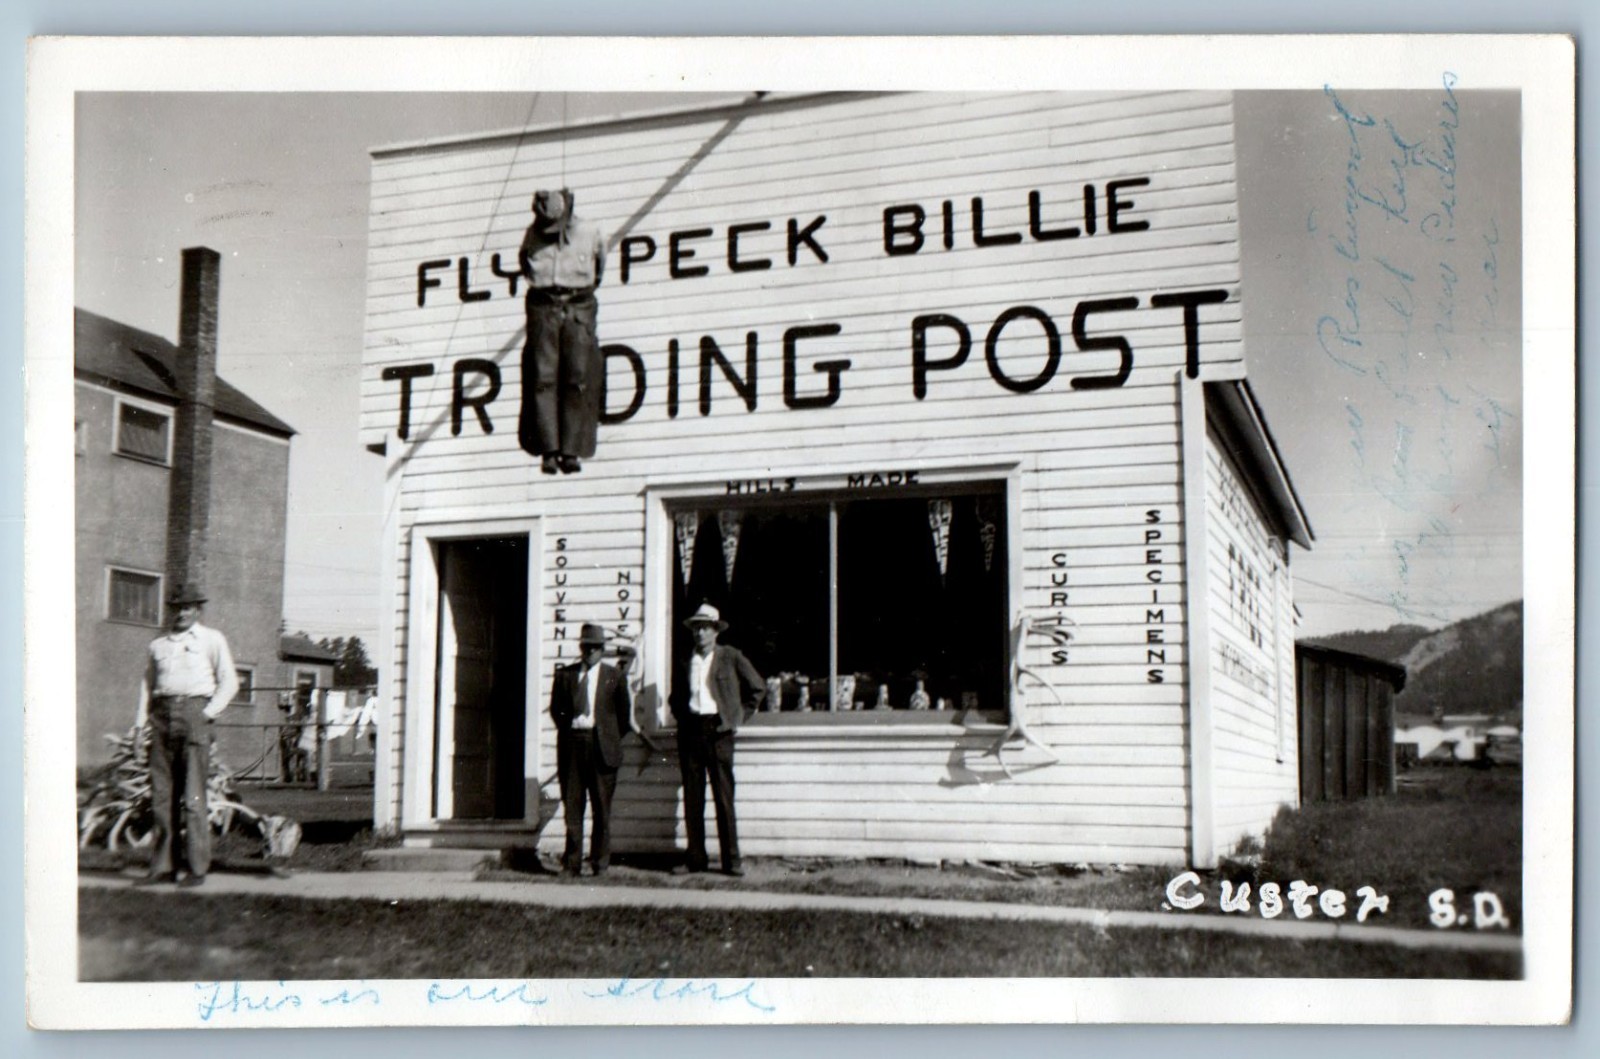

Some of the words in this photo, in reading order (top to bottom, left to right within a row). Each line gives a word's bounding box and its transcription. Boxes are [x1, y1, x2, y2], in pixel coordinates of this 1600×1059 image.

[417, 253, 525, 308] FLY
[883, 176, 1151, 257] BILLIE
[381, 323, 852, 440] TRDING
[911, 289, 1230, 401] POST
[726, 477, 797, 495] HILLS
[847, 470, 920, 488] MADE
[1145, 509, 1166, 685] SPECIMENS
[194, 977, 302, 1021] This
